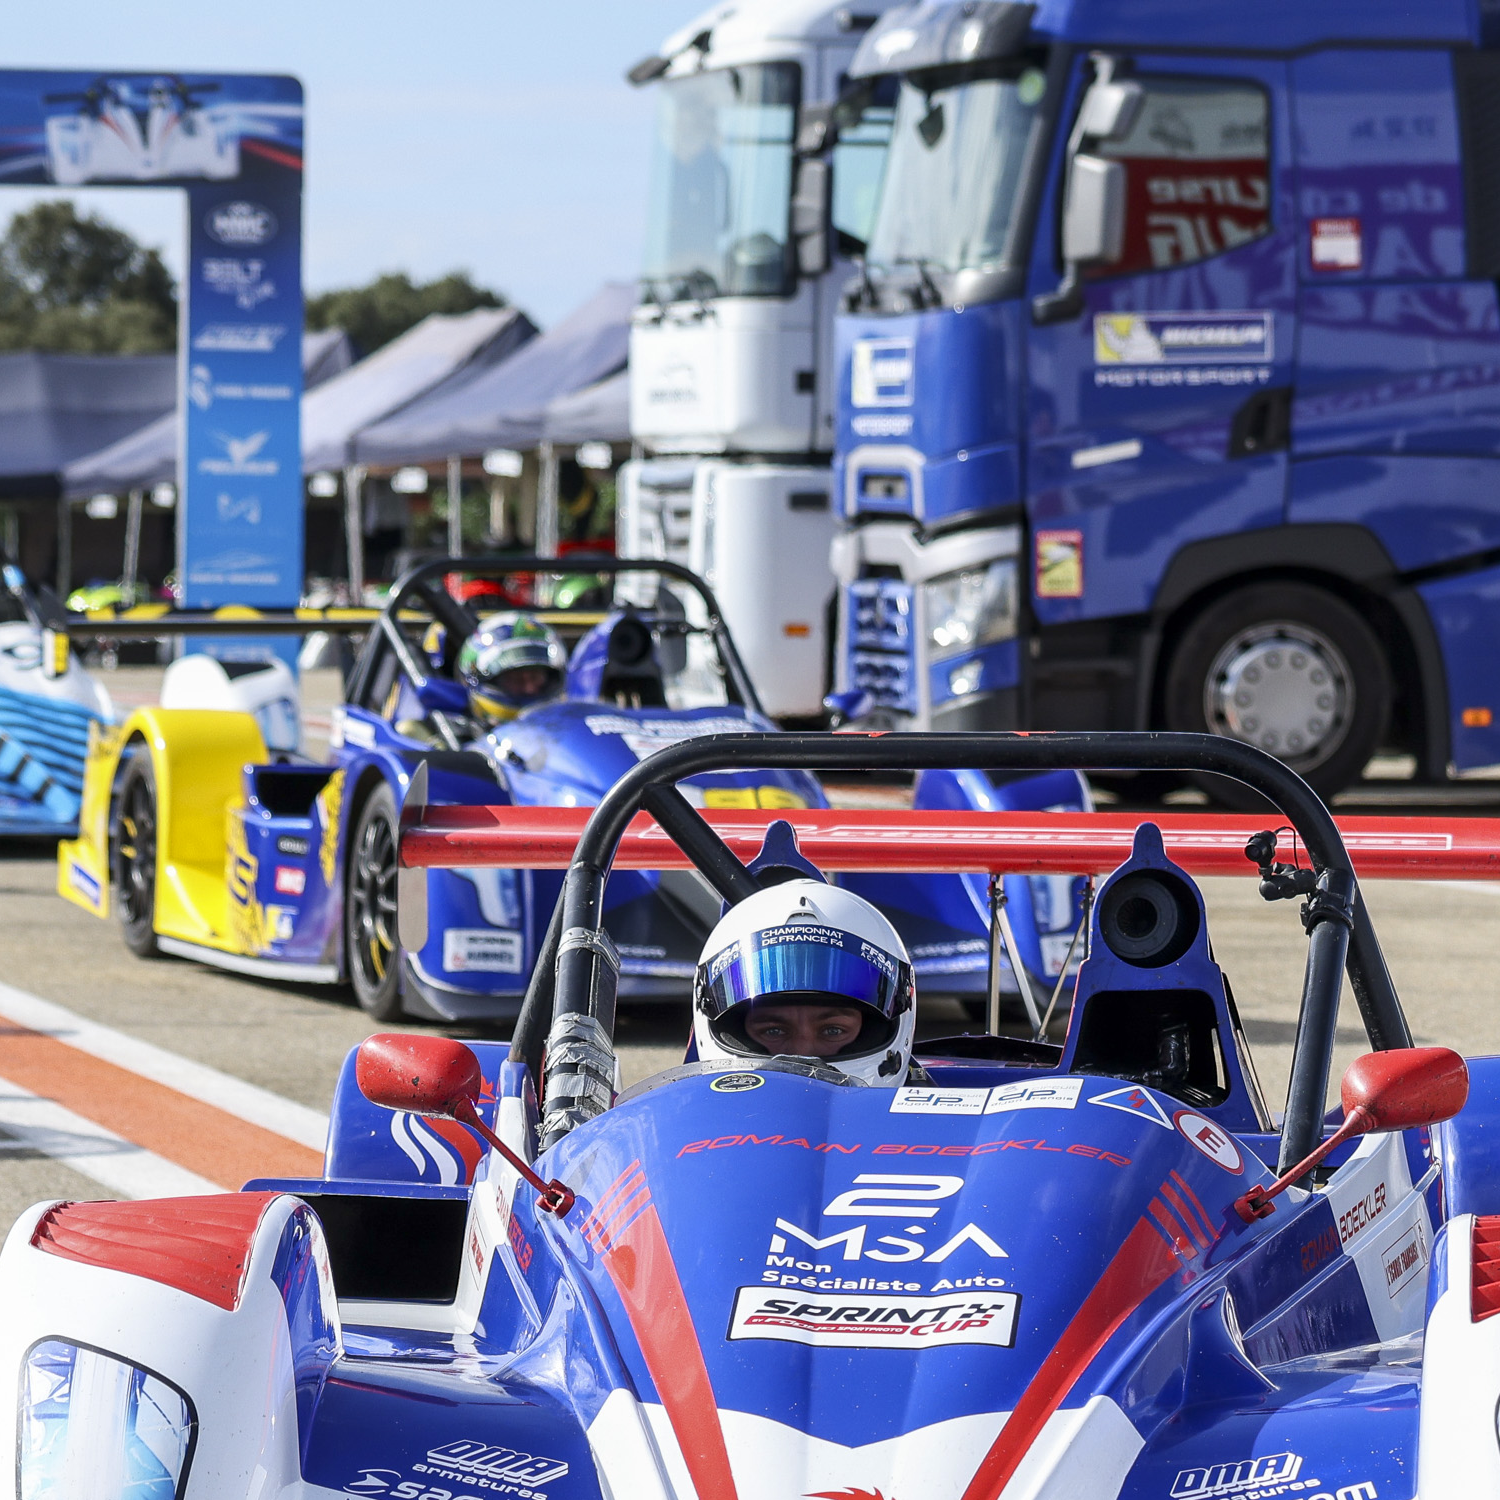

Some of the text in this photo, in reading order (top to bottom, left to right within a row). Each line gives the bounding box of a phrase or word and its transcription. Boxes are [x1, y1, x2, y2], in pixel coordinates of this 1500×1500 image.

[1095, 368, 1271, 386] MOTORSPORT
[761, 926, 844, 939] CHAMPIONNAT
[761, 934, 844, 947] DE FRANCE F4
[861, 942, 894, 971] FFSA
[991, 1099, 1022, 1107] dijon
[1202, 1126, 1226, 1154] E
[675, 1134, 1133, 1168] ROMAIN BOECKLER
[823, 1174, 965, 1218] 2
[1339, 1182, 1387, 1244] BOECKLER
[769, 1217, 1009, 1263] MSA
[766, 1255, 832, 1273] Mon
[761, 1271, 1006, 1292] Spécialiste Auto
[909, 1319, 990, 1336] CUP
